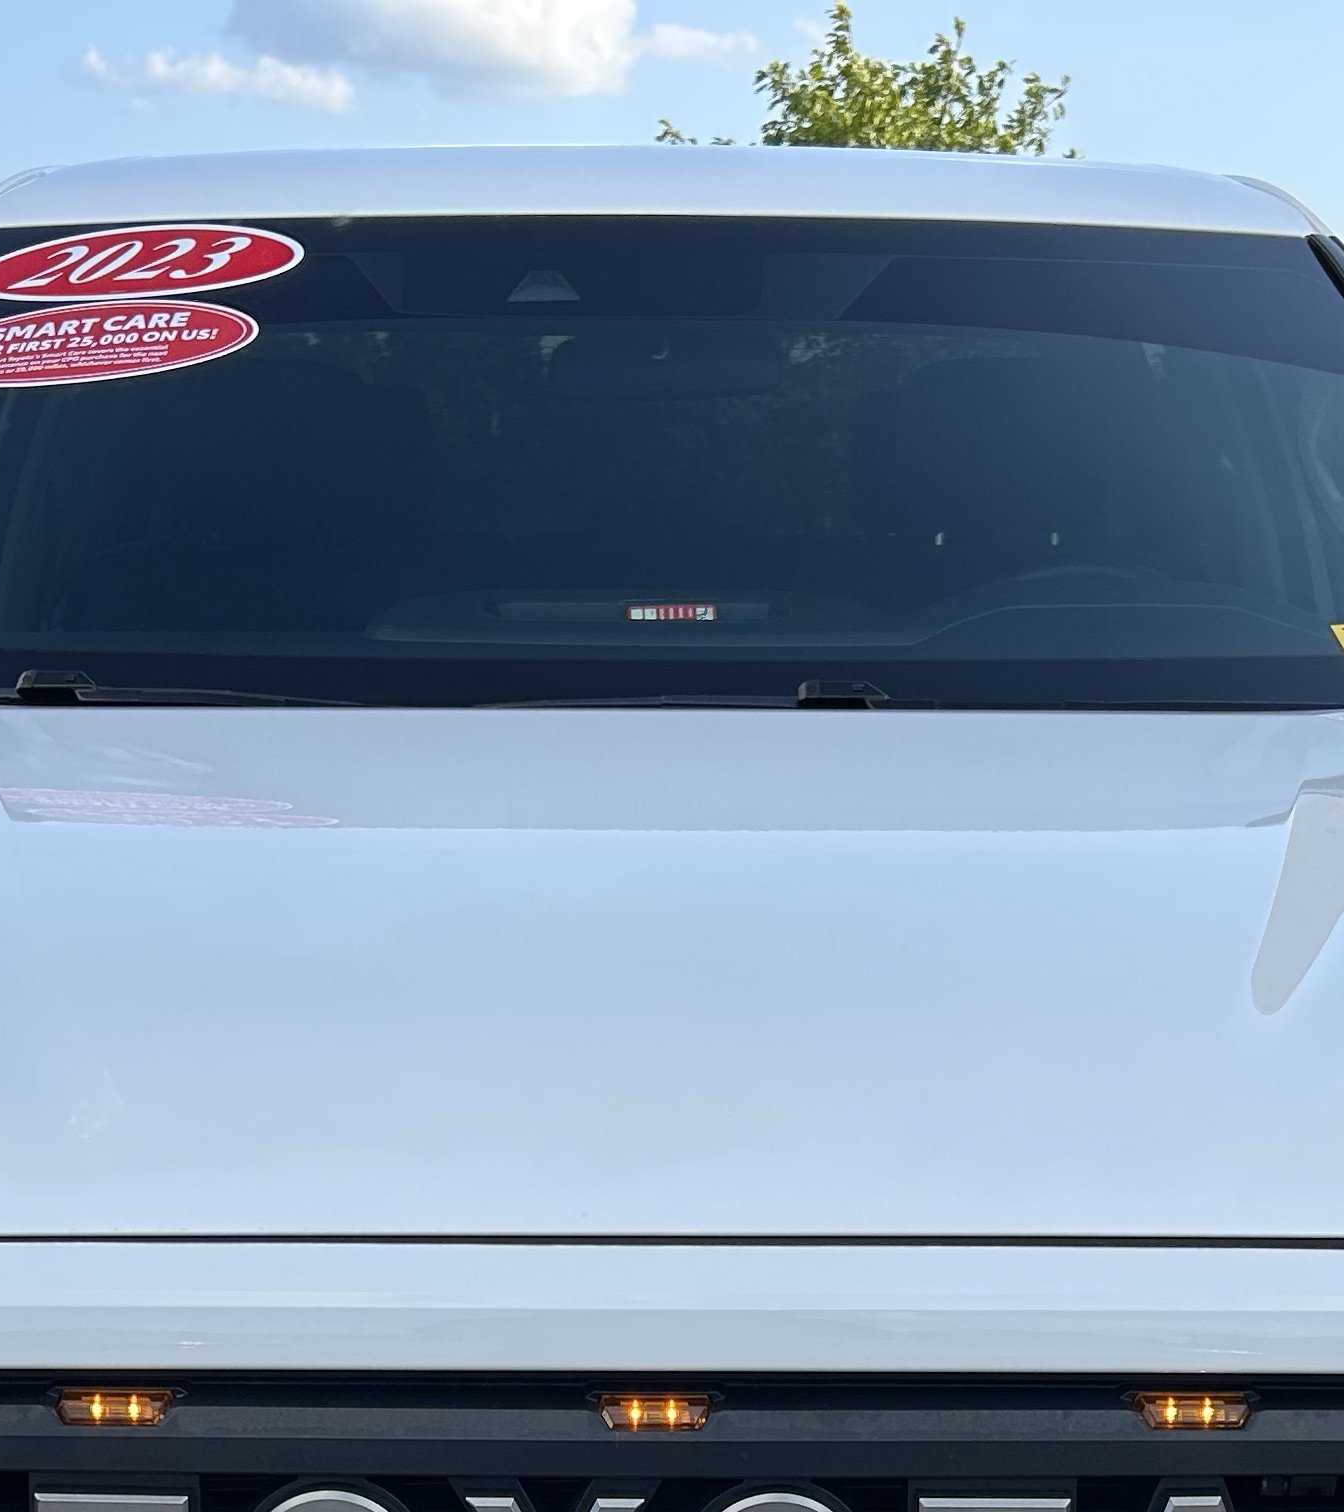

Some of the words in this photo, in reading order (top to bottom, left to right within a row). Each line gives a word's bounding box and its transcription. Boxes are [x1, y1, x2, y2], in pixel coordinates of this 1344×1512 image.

[7, 237, 252, 290] 2023
[103, 311, 191, 332] CARE
[6, 338, 66, 354] FIRST
[67, 331, 139, 348] 25,000
[142, 330, 179, 343] ON
[181, 328, 219, 341] US!
